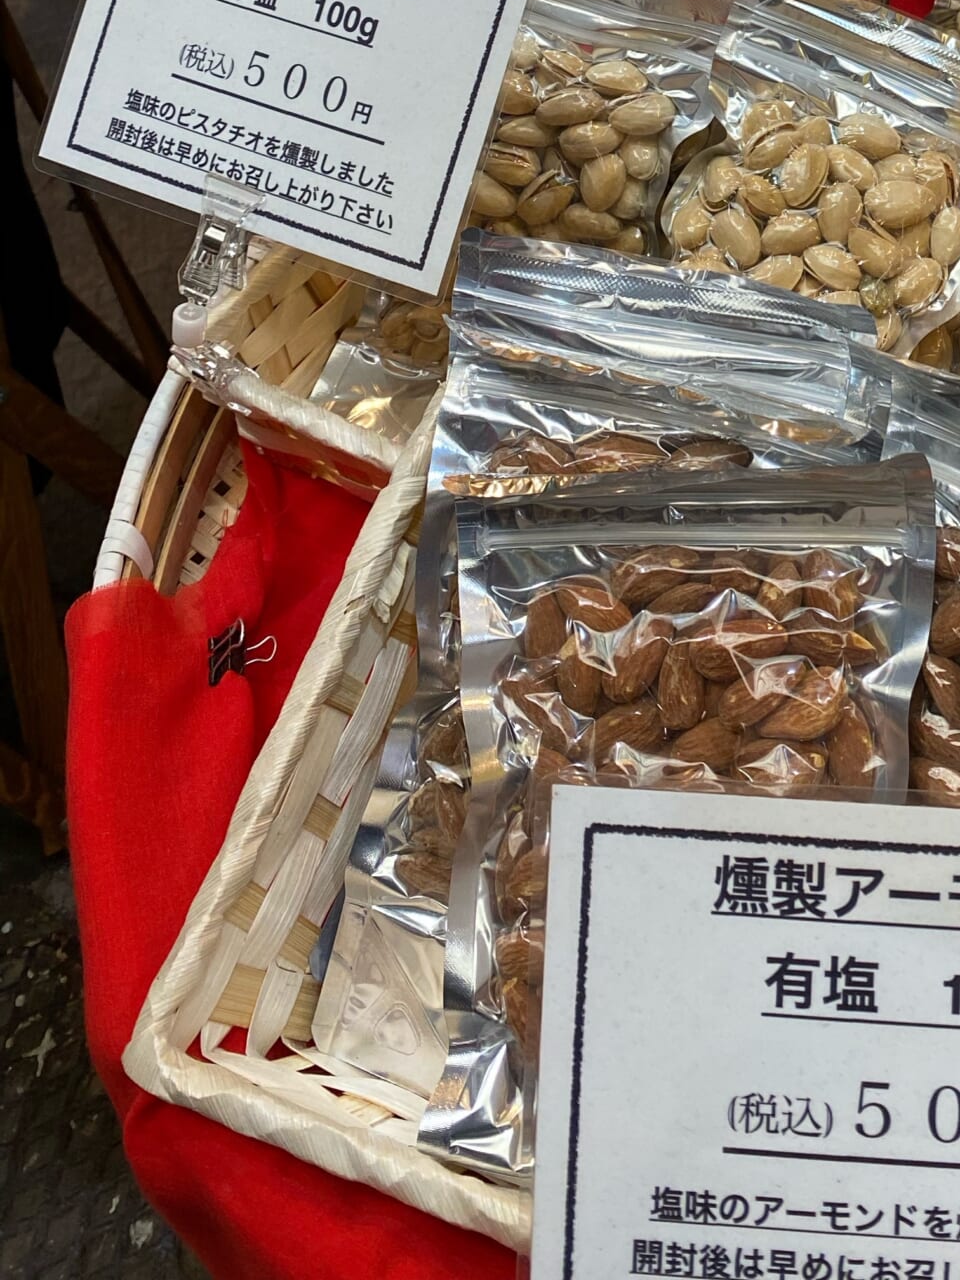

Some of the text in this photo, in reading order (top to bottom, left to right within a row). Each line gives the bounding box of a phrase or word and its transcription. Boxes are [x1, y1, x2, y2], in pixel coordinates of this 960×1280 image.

[106, 116, 393, 231] 開封後は早めにお召し上がり下さい
[124, 89, 395, 195] 塩味のピスタチオを燻製しました
[764, 952, 879, 1014] 有塩
